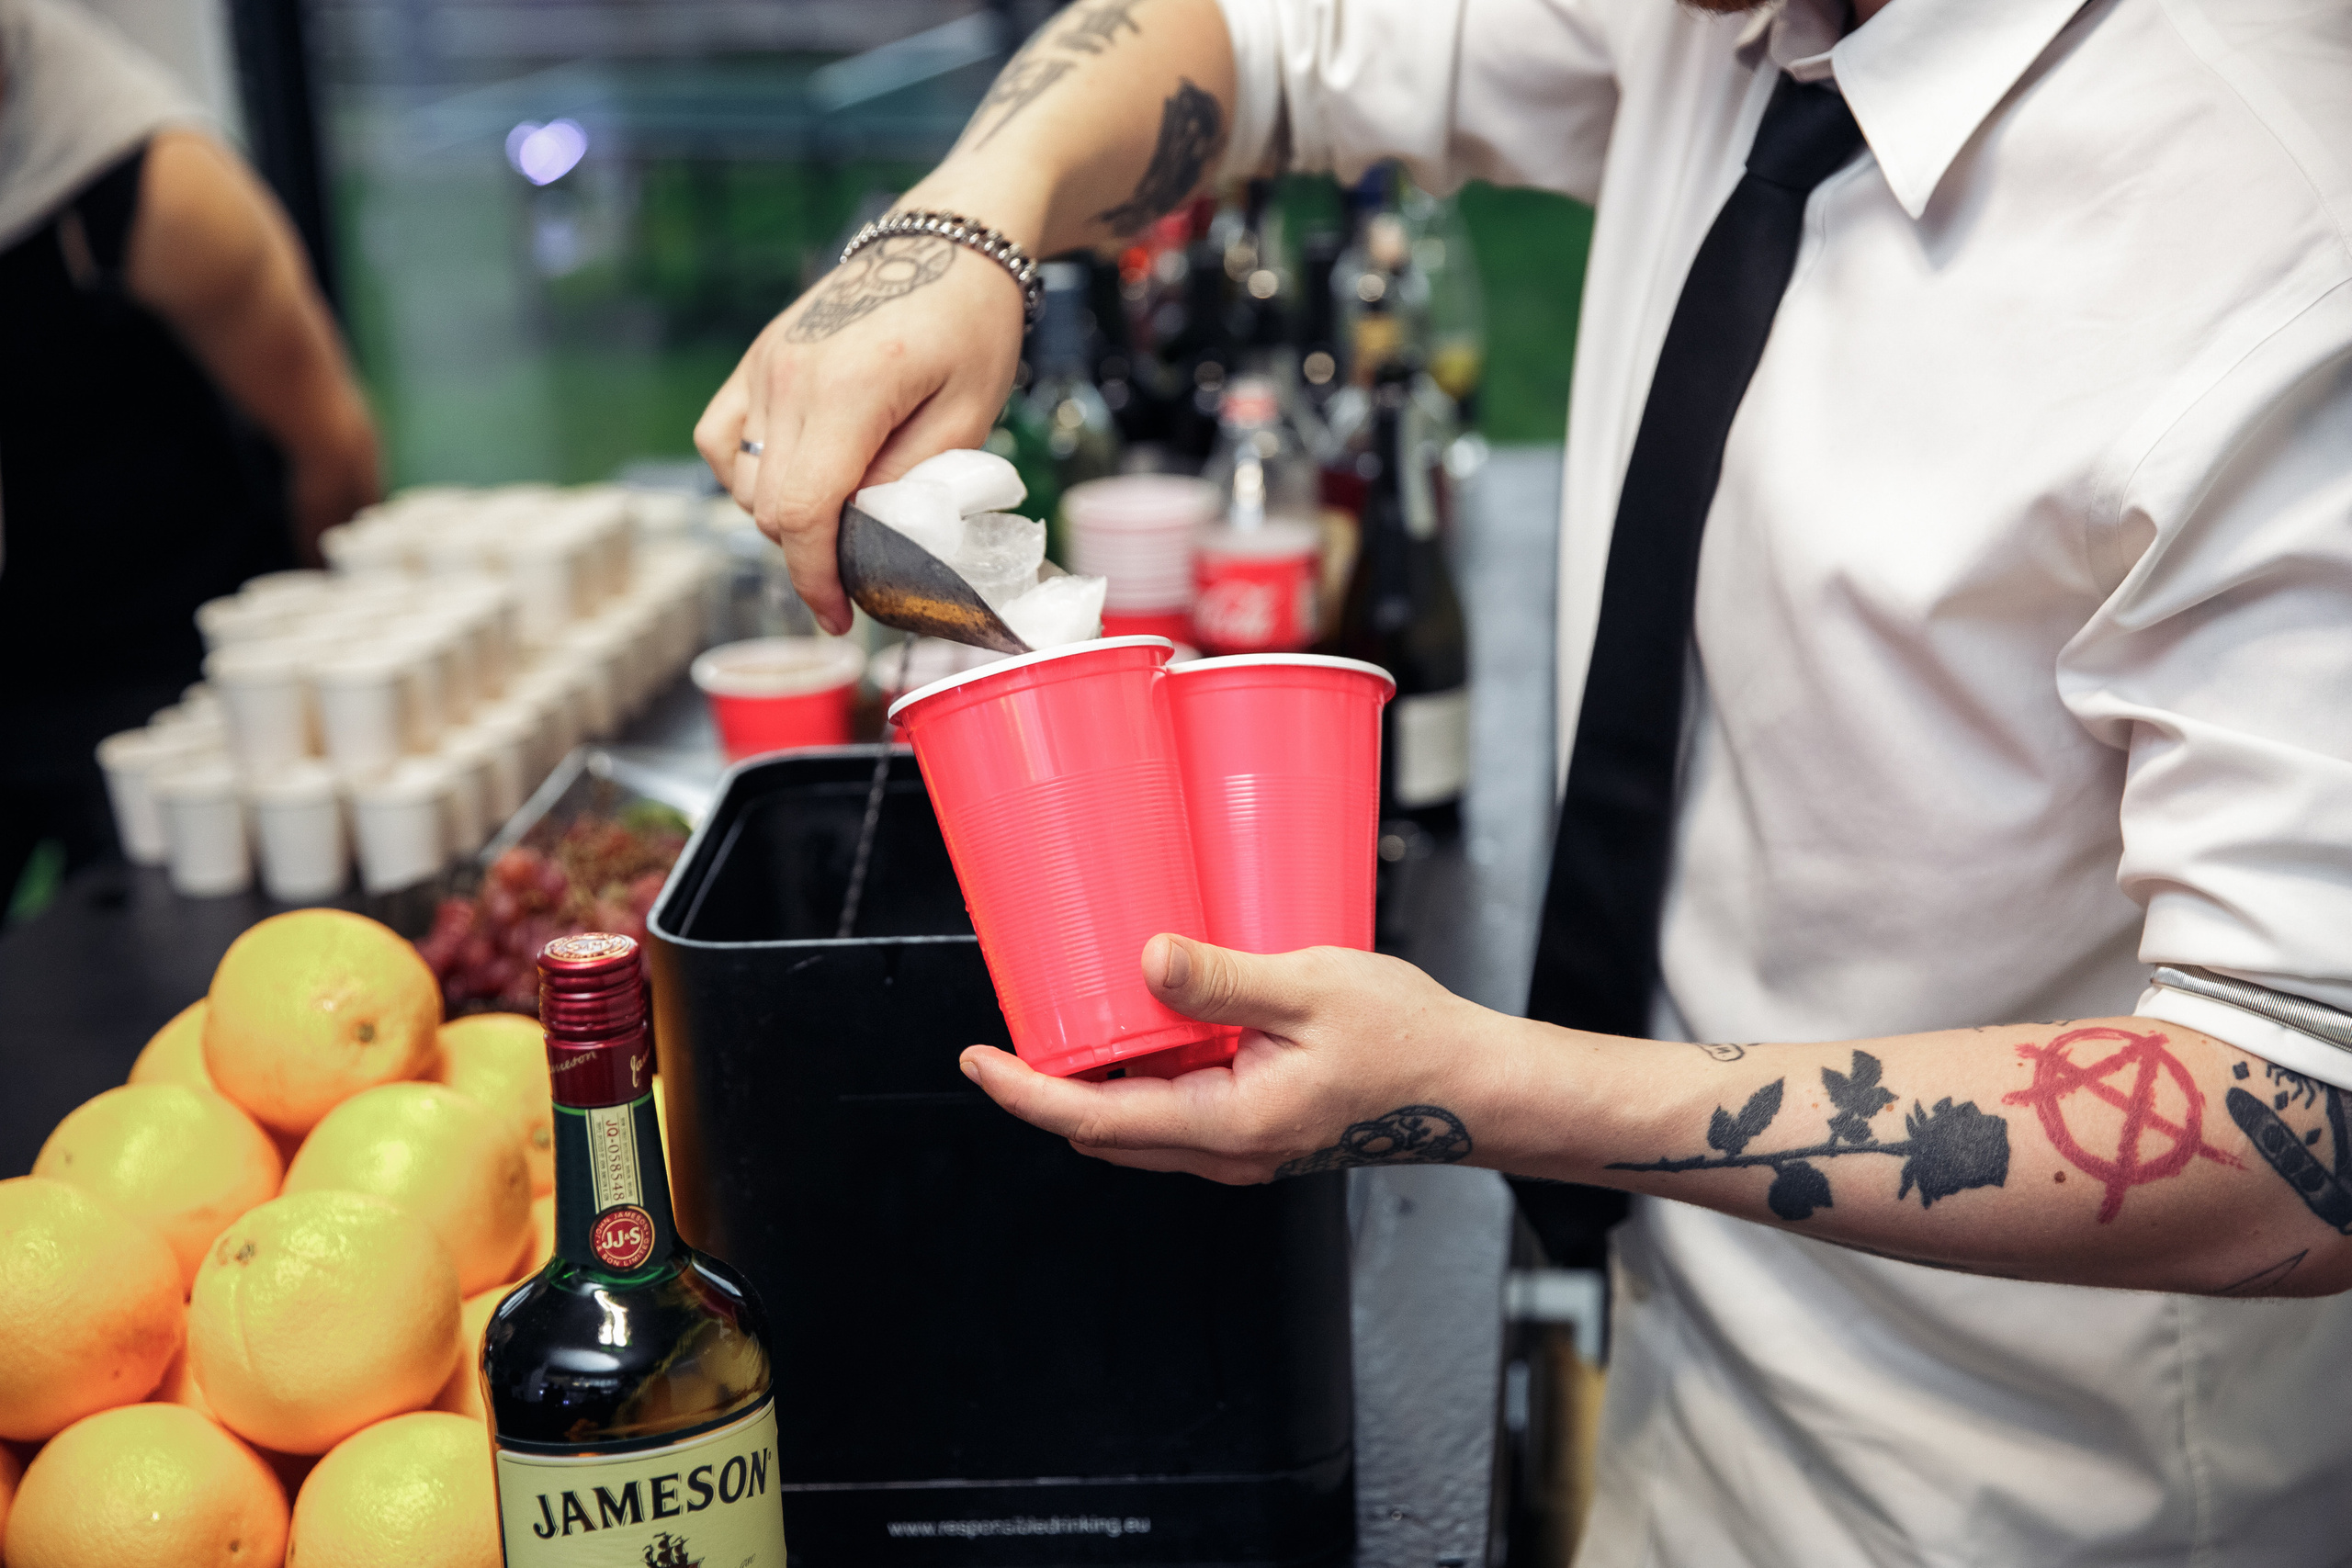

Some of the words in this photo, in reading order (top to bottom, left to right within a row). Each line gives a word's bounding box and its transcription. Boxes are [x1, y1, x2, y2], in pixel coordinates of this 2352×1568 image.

[605, 1120, 625, 1201] JQ-058548
[594, 1217, 610, 1239] JOHN
[614, 1211, 649, 1231] JAMESON
[601, 1226, 641, 1249] JJ&S
[601, 1252, 620, 1267] SON
[623, 1237, 650, 1267] LIMITED
[532, 1447, 769, 1540] JAMESON
[887, 1515, 1151, 1539] www.responsibledrinking.eu
